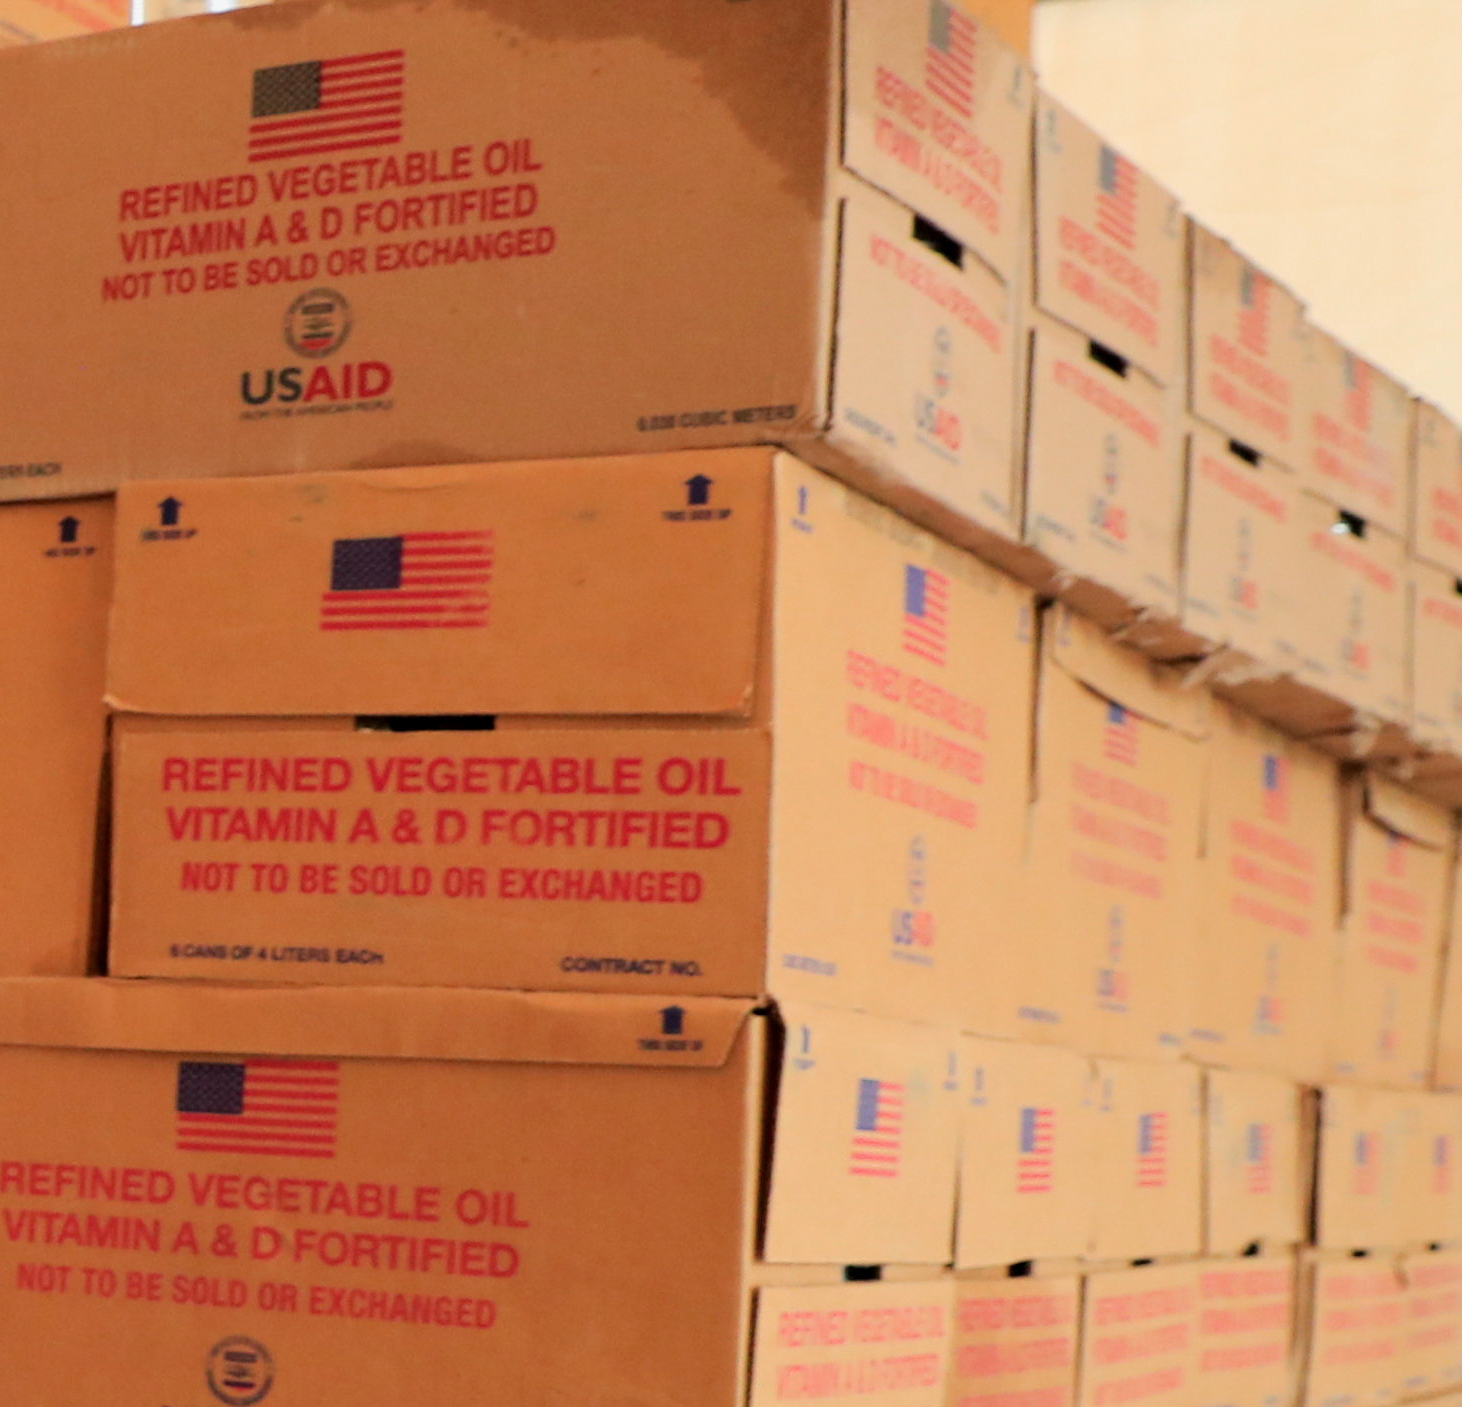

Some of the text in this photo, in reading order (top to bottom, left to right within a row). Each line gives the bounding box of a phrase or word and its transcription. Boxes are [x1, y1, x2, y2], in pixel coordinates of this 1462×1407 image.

[120, 136, 542, 221] REFINED VEGETABLE OIL
[120, 183, 538, 262] VITAMIN A & D FORTIFIED
[102, 225, 556, 301] NOT TO BE SOLD OR EXCHANGED
[241, 361, 392, 405] USAID
[163, 757, 741, 795] REFINED VEGETABLE OIL
[167, 807, 730, 848] VITAMIN A & D FORTIFIED
[181, 862, 703, 903] NOT TO BE SOLD OR EXCHANGED
[561, 957, 664, 974] CONTRACT
[0, 1160, 529, 1228] REFINED VEGETABLE OIL
[3, 1209, 519, 1278] VITAMIN A & D FORTIFIED
